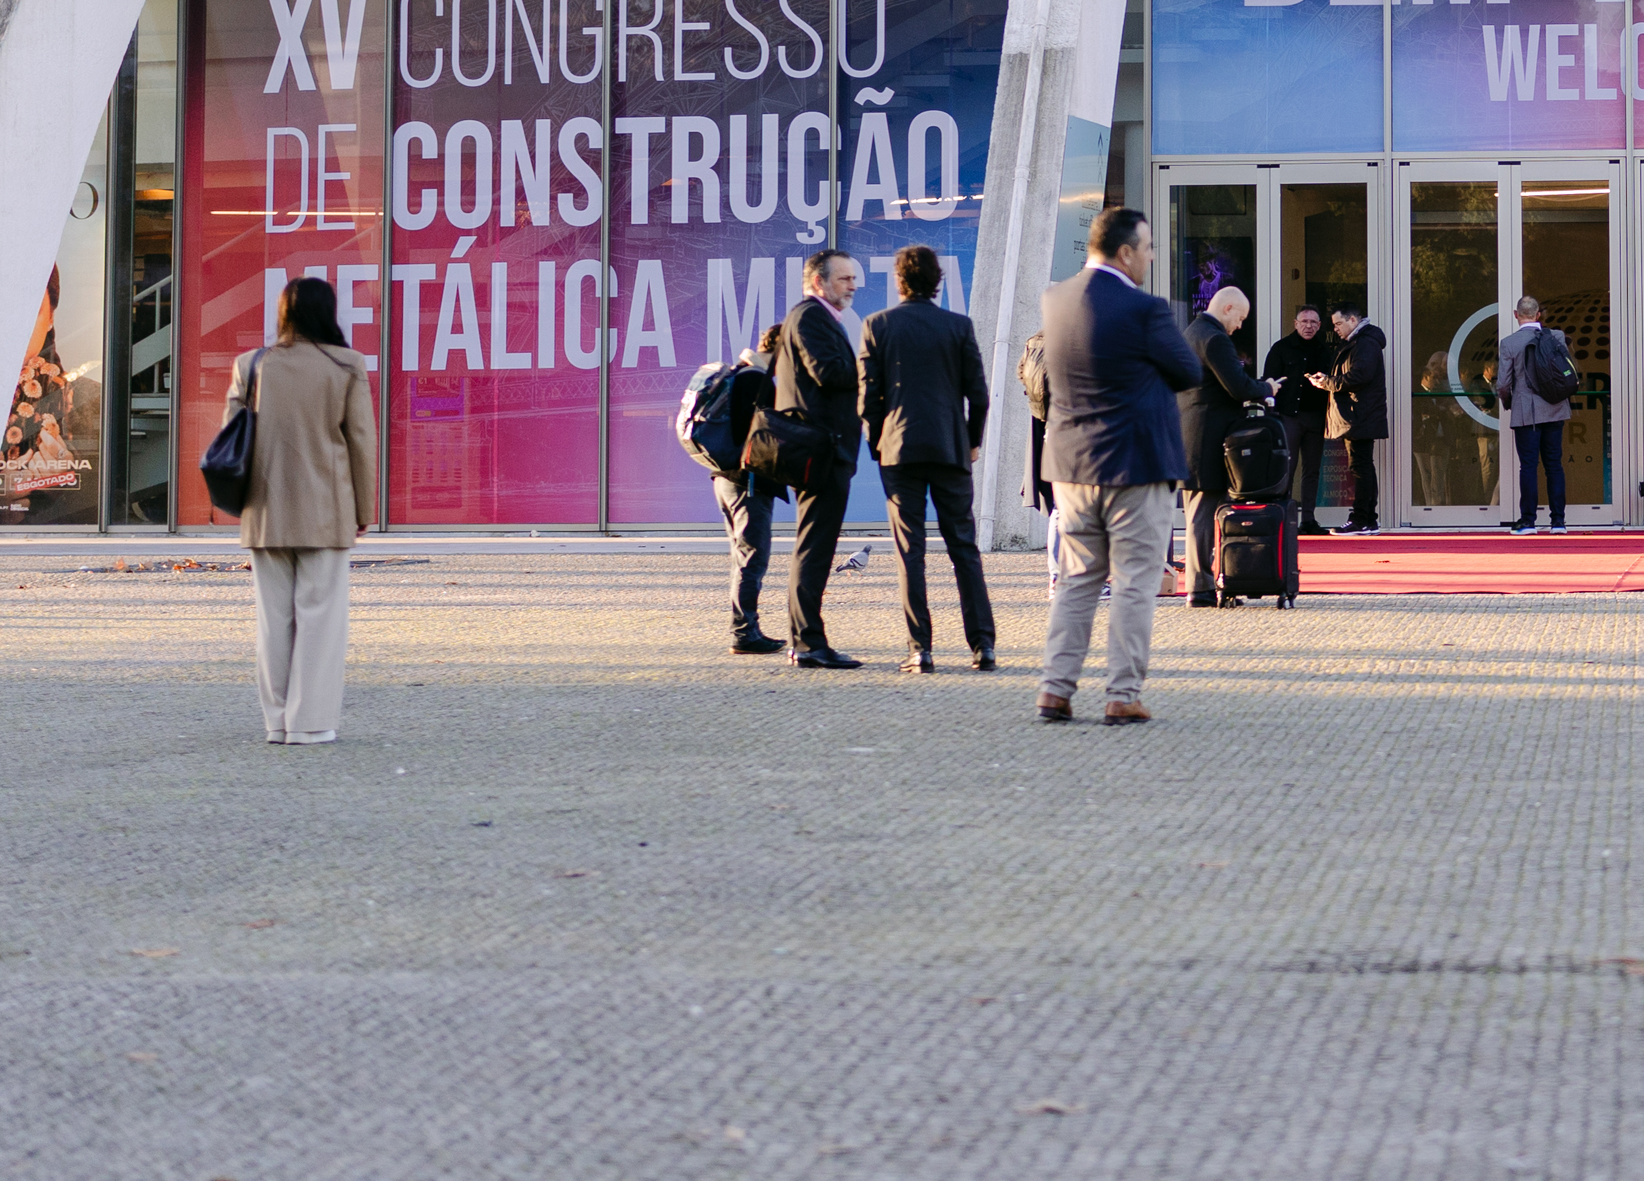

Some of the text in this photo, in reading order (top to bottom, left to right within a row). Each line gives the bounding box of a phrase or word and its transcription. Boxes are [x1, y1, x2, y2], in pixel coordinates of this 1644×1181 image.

[265, 87, 960, 245] DE CONSTRUÇÃO
[35, 459, 92, 470] ARENA
[17, 473, 75, 492] ESGOTADO
